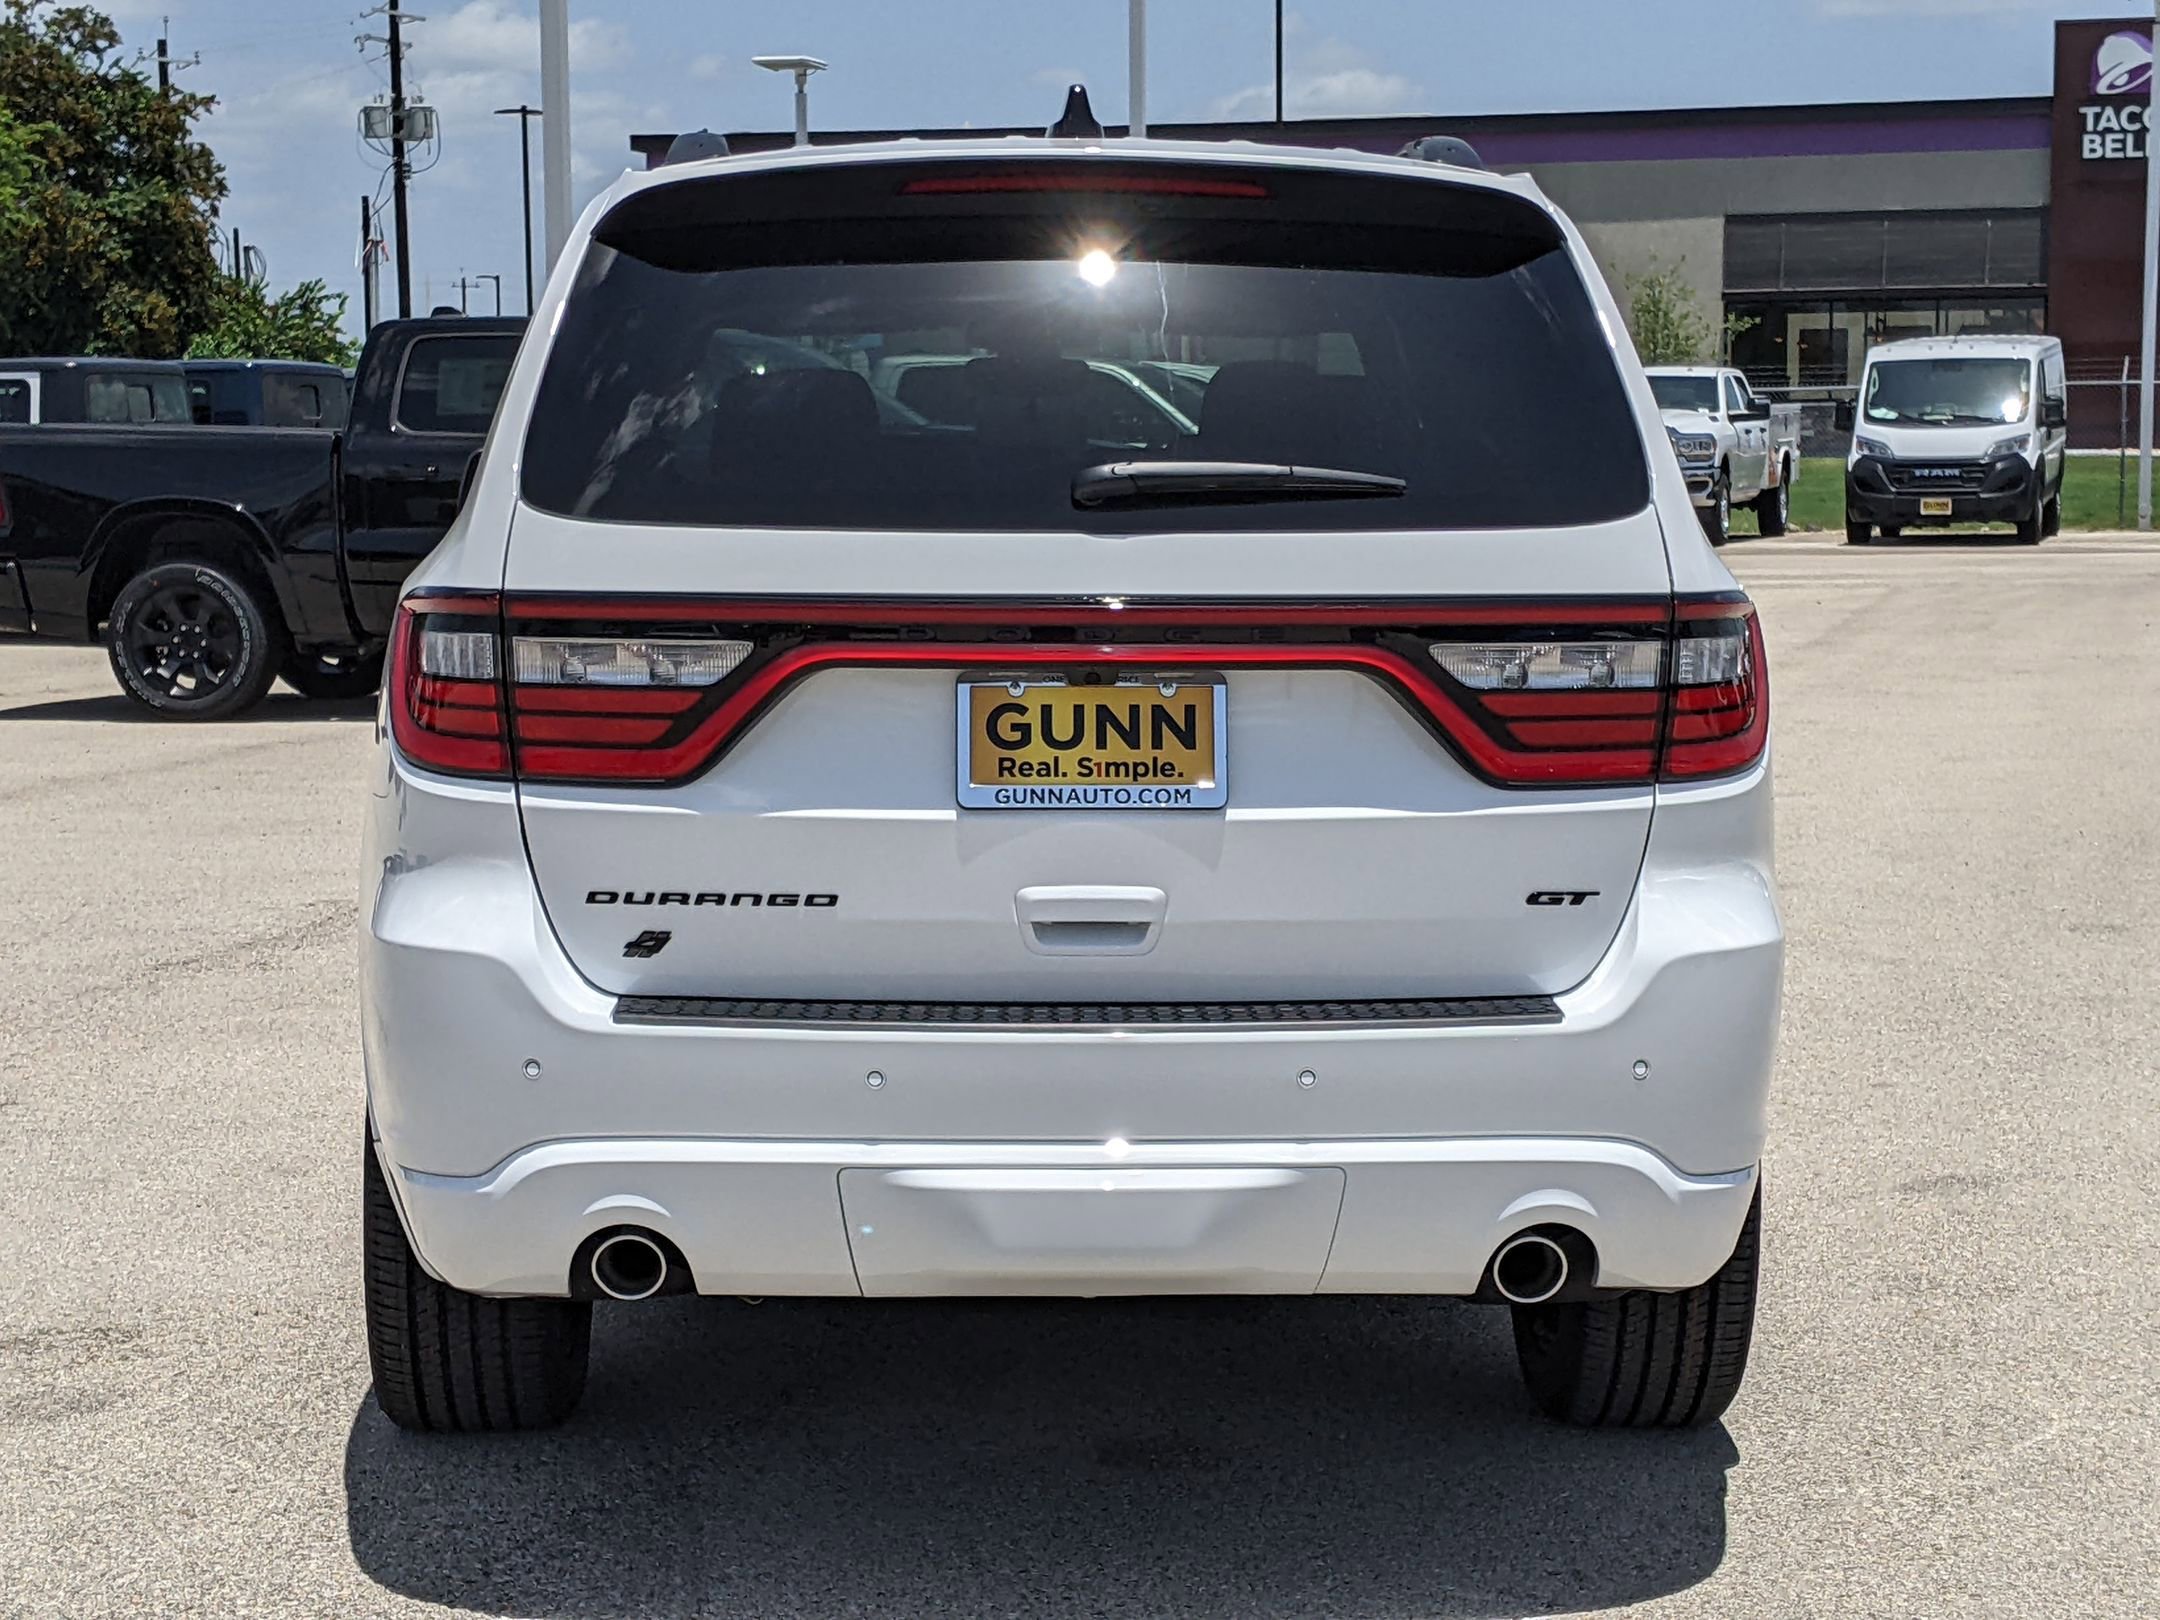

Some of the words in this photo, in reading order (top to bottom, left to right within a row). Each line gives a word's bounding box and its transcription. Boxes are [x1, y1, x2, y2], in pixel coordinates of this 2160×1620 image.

[2082, 133, 2150, 159] BEL
[1914, 468, 1961, 477] RAM
[985, 702, 1198, 751] GUNN
[997, 756, 1068, 779] Real.
[994, 788, 1192, 805] GUNNAUTO.COM
[584, 891, 839, 907] DURANGO
[1525, 892, 1601, 906] GT
